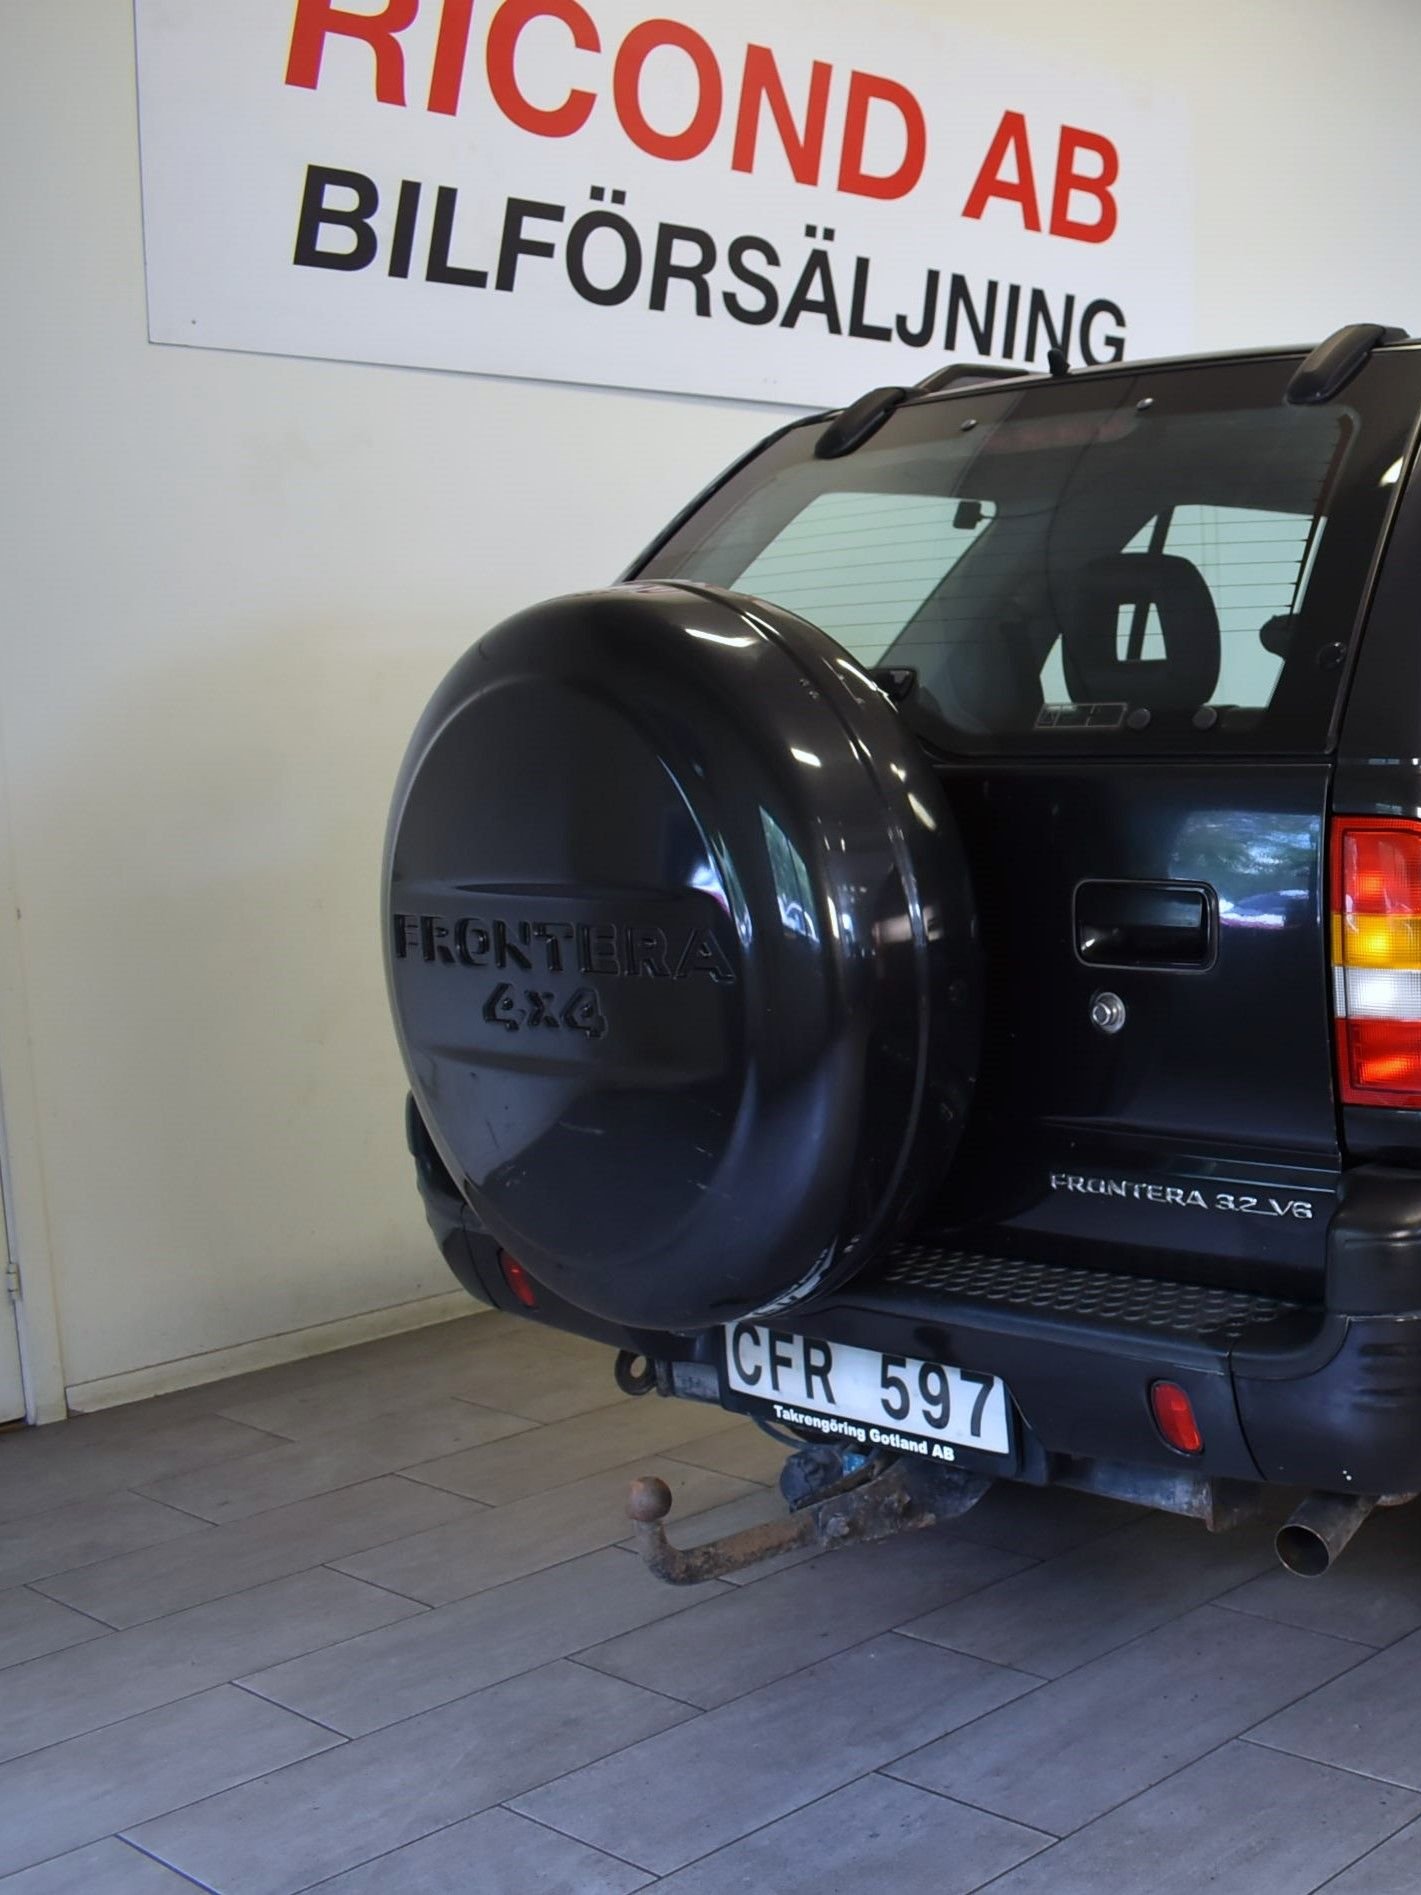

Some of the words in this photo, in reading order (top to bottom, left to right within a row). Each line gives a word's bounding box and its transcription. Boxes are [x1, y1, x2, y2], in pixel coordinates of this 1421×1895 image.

[284, 0, 927, 202] RICOND
[962, 110, 1121, 244] AB
[292, 164, 1127, 367] BILFÖRSÄLJNING
[394, 913, 736, 983] FRONTERA
[1050, 1173, 1208, 1210] FRONTERA
[1269, 1199, 1313, 1219] V6
[731, 1321, 836, 1405] CFR
[880, 1353, 995, 1437] 597
[773, 1404, 866, 1442] Takrengöring
[869, 1429, 928, 1456] Gotland
[931, 1443, 955, 1462] AB
